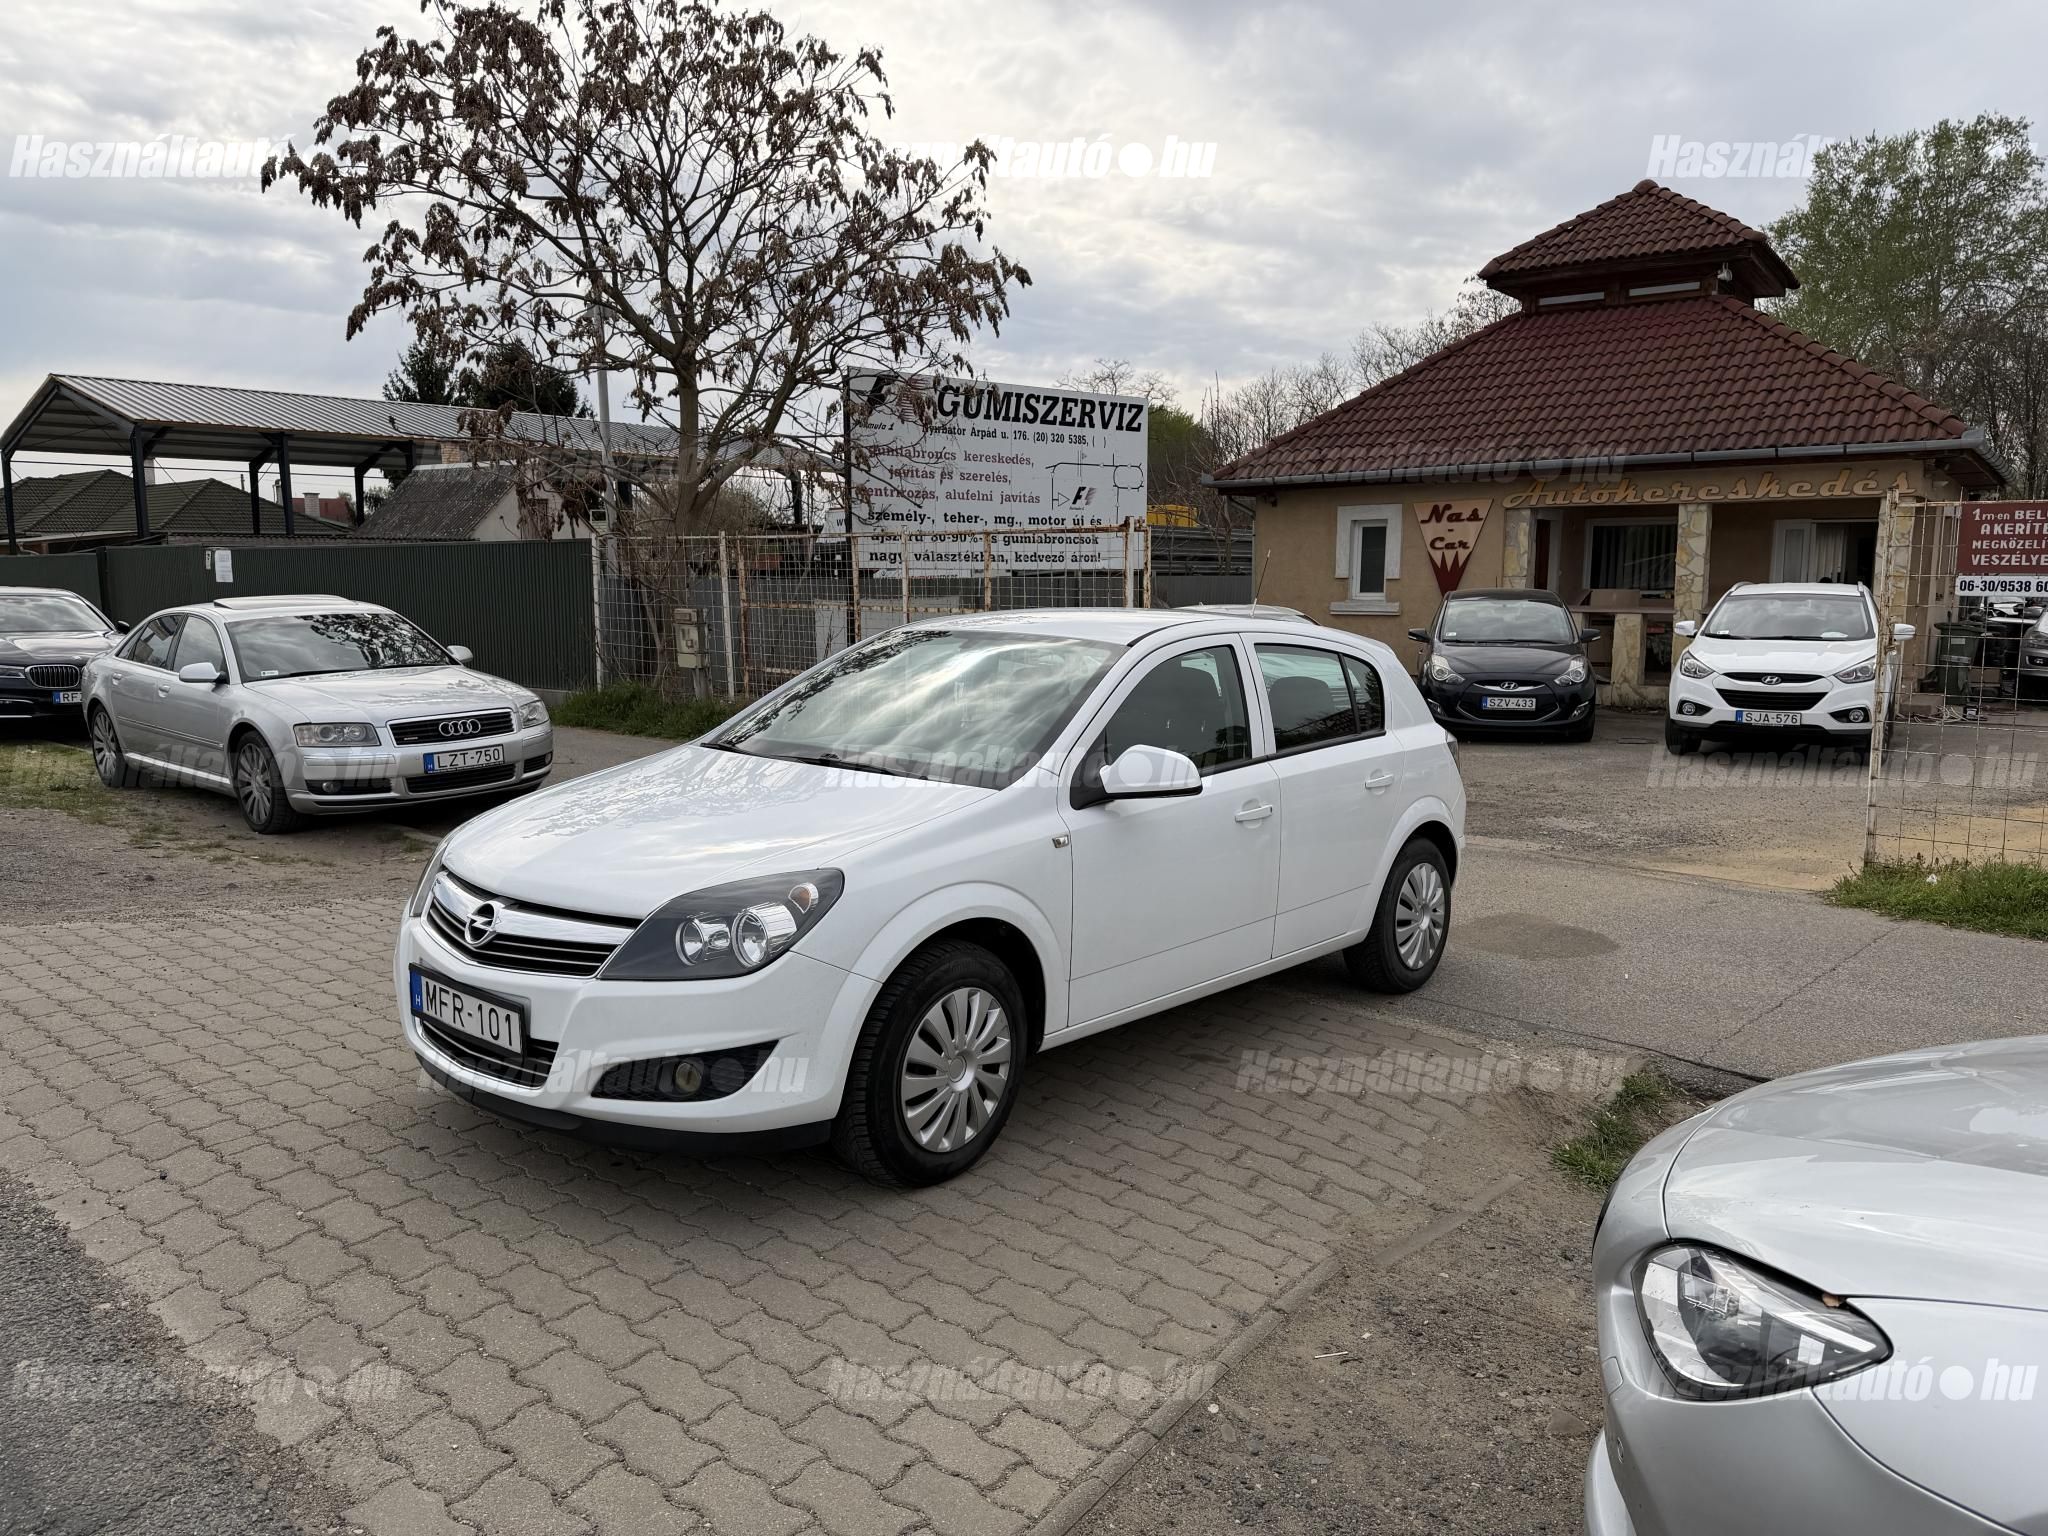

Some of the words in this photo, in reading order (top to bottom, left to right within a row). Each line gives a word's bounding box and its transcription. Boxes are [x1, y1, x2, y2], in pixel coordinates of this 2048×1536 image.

[938, 384, 1144, 432] GUMISZERVIZ
[970, 422, 997, 439] Árpád
[1001, 430, 1009, 439] u.
[1013, 430, 1030, 441] 176.
[1033, 432, 1048, 444] (20)
[1050, 433, 1065, 444] 320
[868, 444, 957, 460] gumiabroncs
[963, 449, 1034, 468] kereskedés,
[889, 465, 936, 480] javítás
[940, 467, 954, 480] és
[959, 471, 1011, 485] szerelés,
[945, 488, 993, 502] alufelni
[999, 490, 1041, 505] javítás
[1502, 468, 1917, 508] Autókereskedés
[868, 509, 935, 525] személy-,
[943, 511, 988, 526] teher-,
[994, 515, 1022, 527] mg.,
[1028, 515, 1066, 526] motor
[1090, 515, 1102, 526] és
[2014, 509, 2048, 520] BEL
[1002, 532, 1099, 546] gumiabroncsok
[1429, 536, 1470, 550] Car
[1972, 537, 2048, 549] MEGKÖZELÍ
[1014, 551, 1065, 564] kedvező
[1071, 551, 1102, 563] áron!
[1959, 580, 2032, 592] 06-30/9538
[1489, 698, 1534, 708] SZV-433
[1745, 712, 1798, 724] SJA-576
[437, 748, 500, 768] LZT-750
[425, 981, 512, 1047] MFR-101
